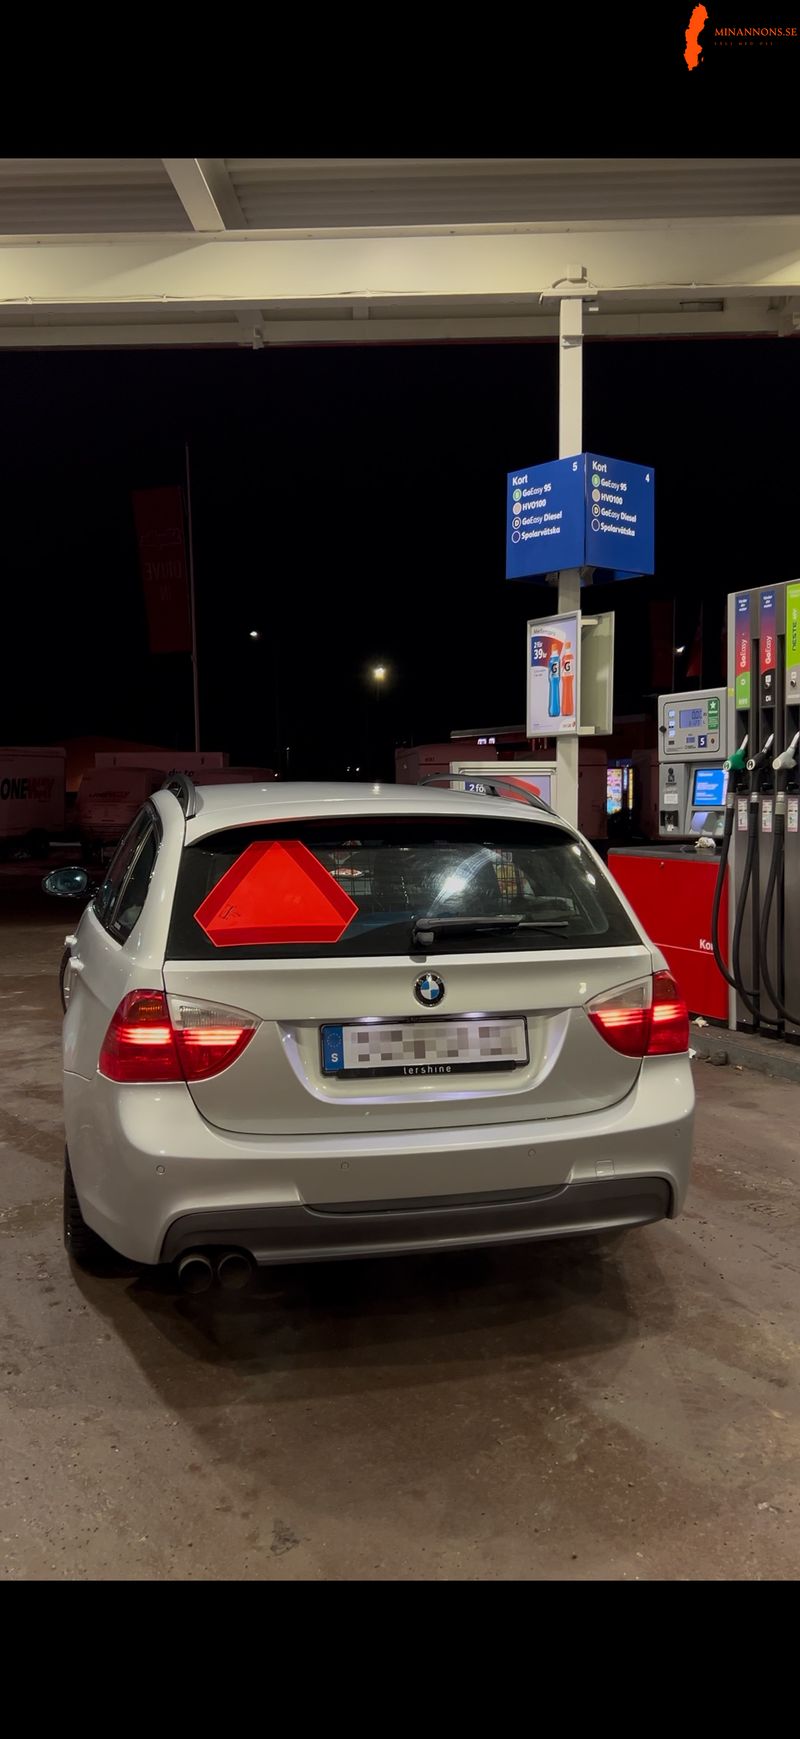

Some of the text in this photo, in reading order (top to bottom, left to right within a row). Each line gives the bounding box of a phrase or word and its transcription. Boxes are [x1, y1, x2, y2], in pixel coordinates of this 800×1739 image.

[572, 461, 578, 472] 5
[592, 460, 607, 473] Kort
[512, 474, 528, 486] Kort
[645, 473, 650, 483] 4
[522, 483, 552, 498] GoEasy 95
[601, 478, 627, 492] GoEasy 95
[522, 499, 547, 511] HVO100
[601, 493, 623, 505] HVO100
[522, 515, 543, 526] GoEasy
[543, 510, 562, 522] Diesel
[600, 507, 620, 521] GoEasy
[620, 510, 637, 523] Diesel
[551, 663, 558, 674] G
[564, 661, 571, 672] G
[700, 737, 705, 746] 5
[469, 783, 475, 792] 2
[331, 1053, 339, 1063] S
